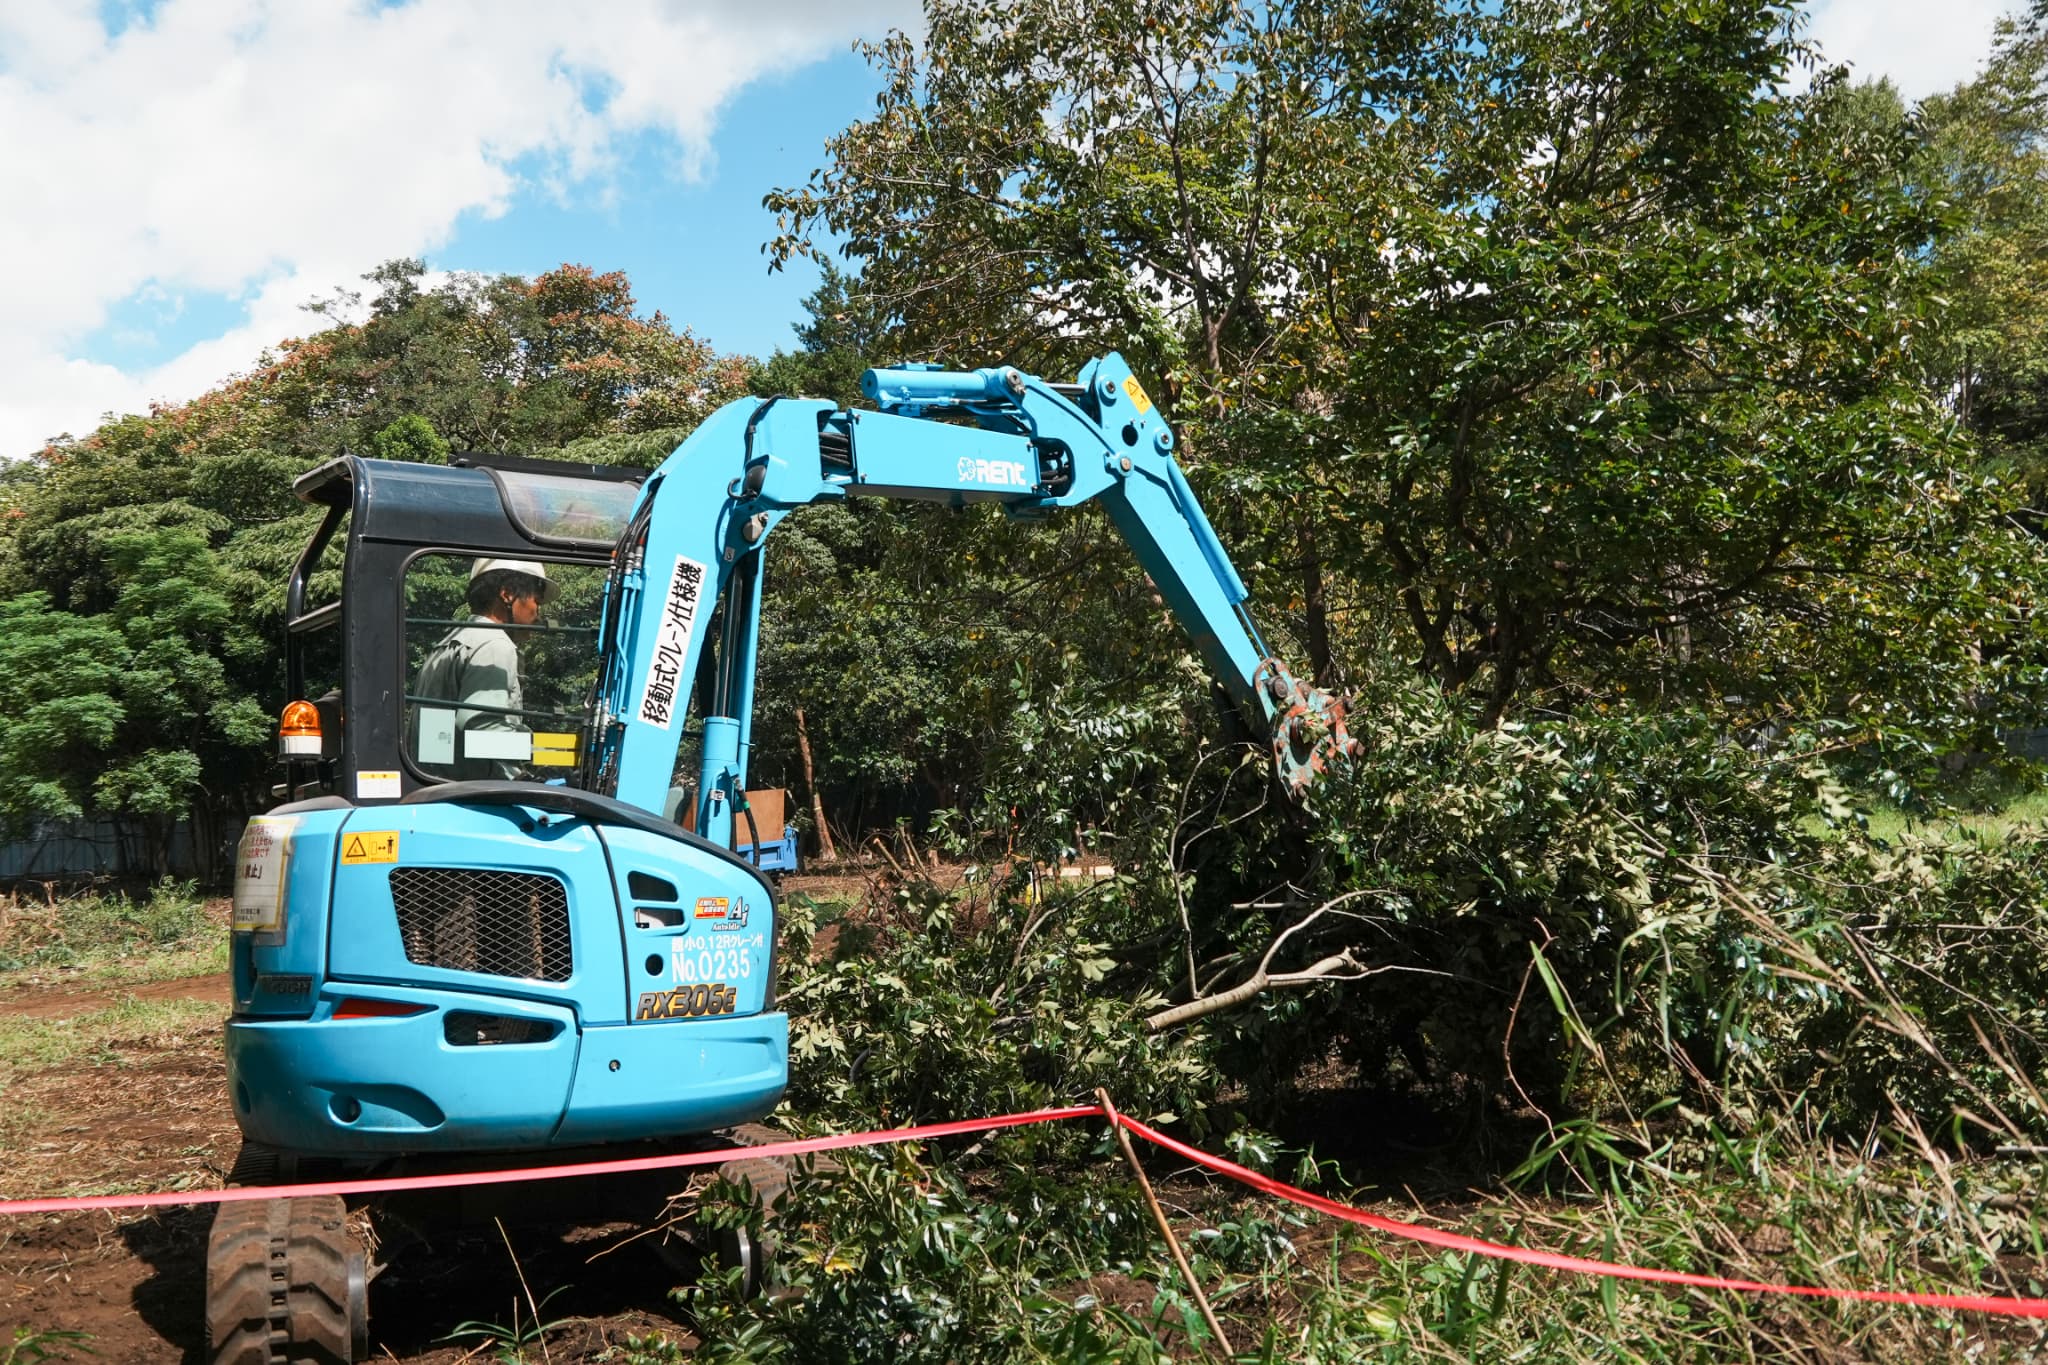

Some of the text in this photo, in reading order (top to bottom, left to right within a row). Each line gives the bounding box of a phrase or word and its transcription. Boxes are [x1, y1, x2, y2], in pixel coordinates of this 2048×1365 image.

[641, 562, 702, 723] 移動式クレーン仕様機
[671, 948, 751, 982] No.0235
[636, 983, 737, 1020] RX306E
